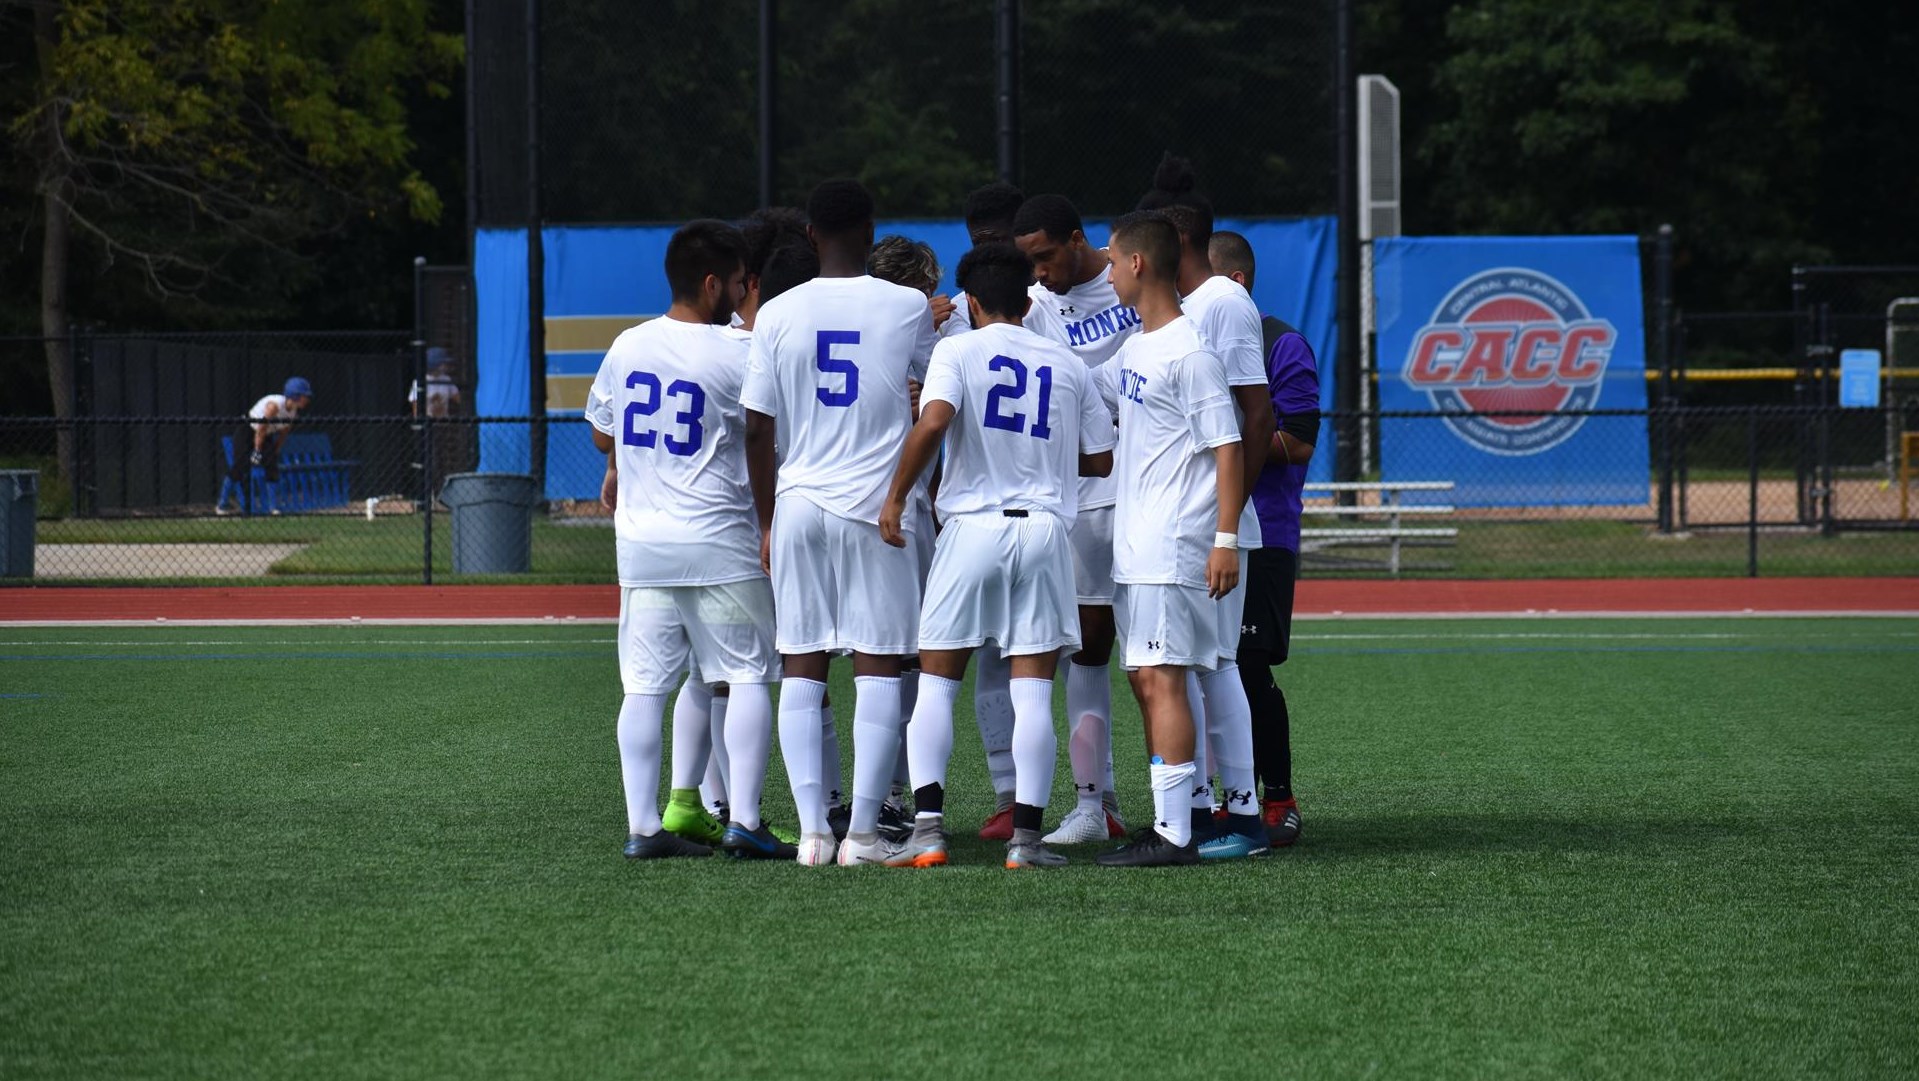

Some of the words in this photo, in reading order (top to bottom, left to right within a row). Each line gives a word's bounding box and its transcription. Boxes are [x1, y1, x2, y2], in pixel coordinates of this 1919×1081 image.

[1065, 303, 1142, 346] MONRO
[1509, 278, 1569, 310] ATLANTIC
[817, 331, 860, 407] 5
[1406, 324, 1614, 386] CACC
[623, 371, 705, 456] 23
[984, 354, 1052, 440] 21
